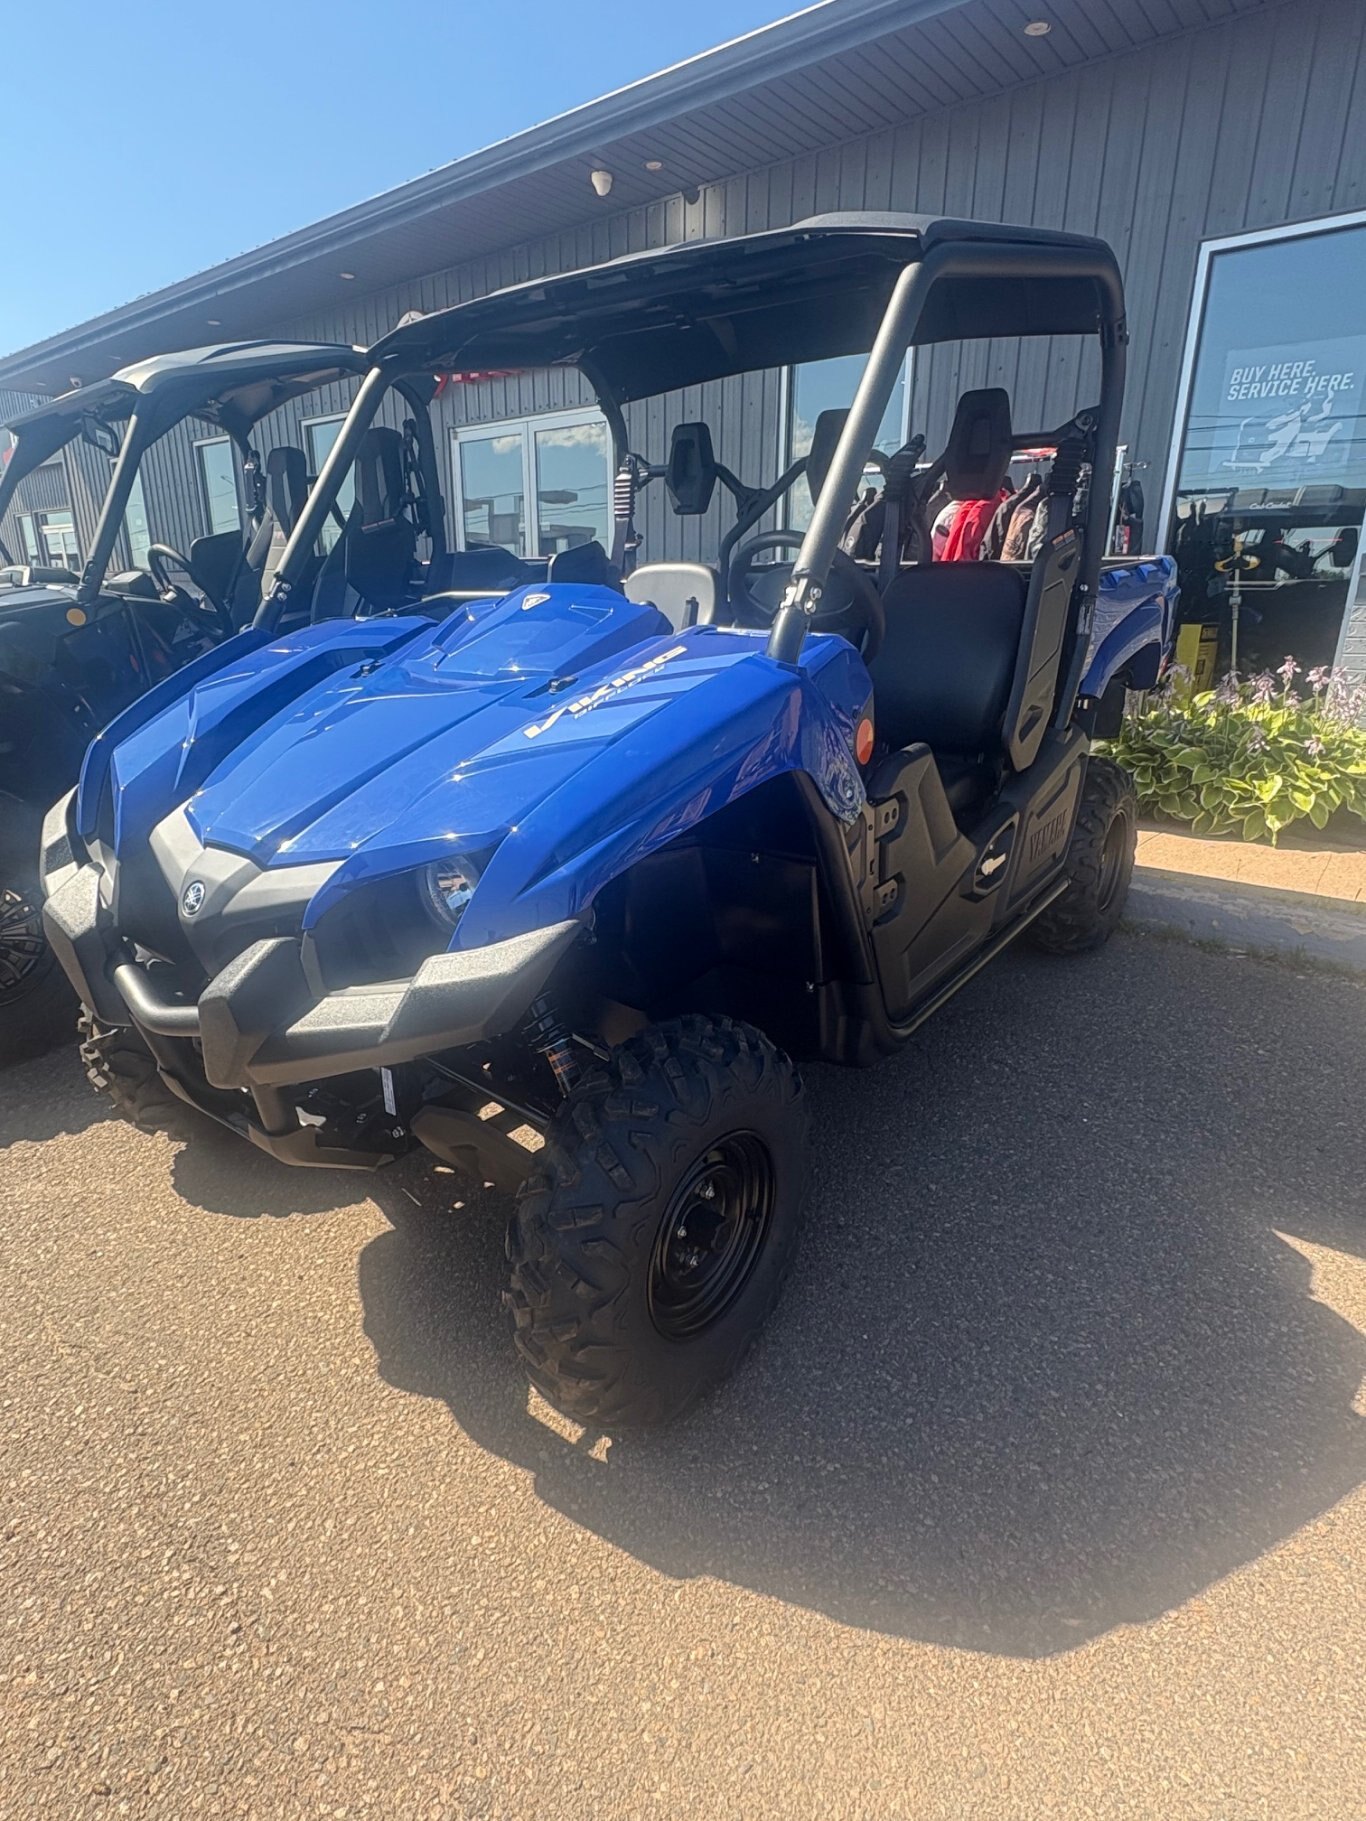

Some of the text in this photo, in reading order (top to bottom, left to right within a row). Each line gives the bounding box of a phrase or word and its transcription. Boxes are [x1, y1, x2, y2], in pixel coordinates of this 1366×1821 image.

[1227, 372, 1354, 401] SERVICE HERE.
[1230, 360, 1316, 385] BUY HERE.
[523, 645, 688, 739] VIKING
